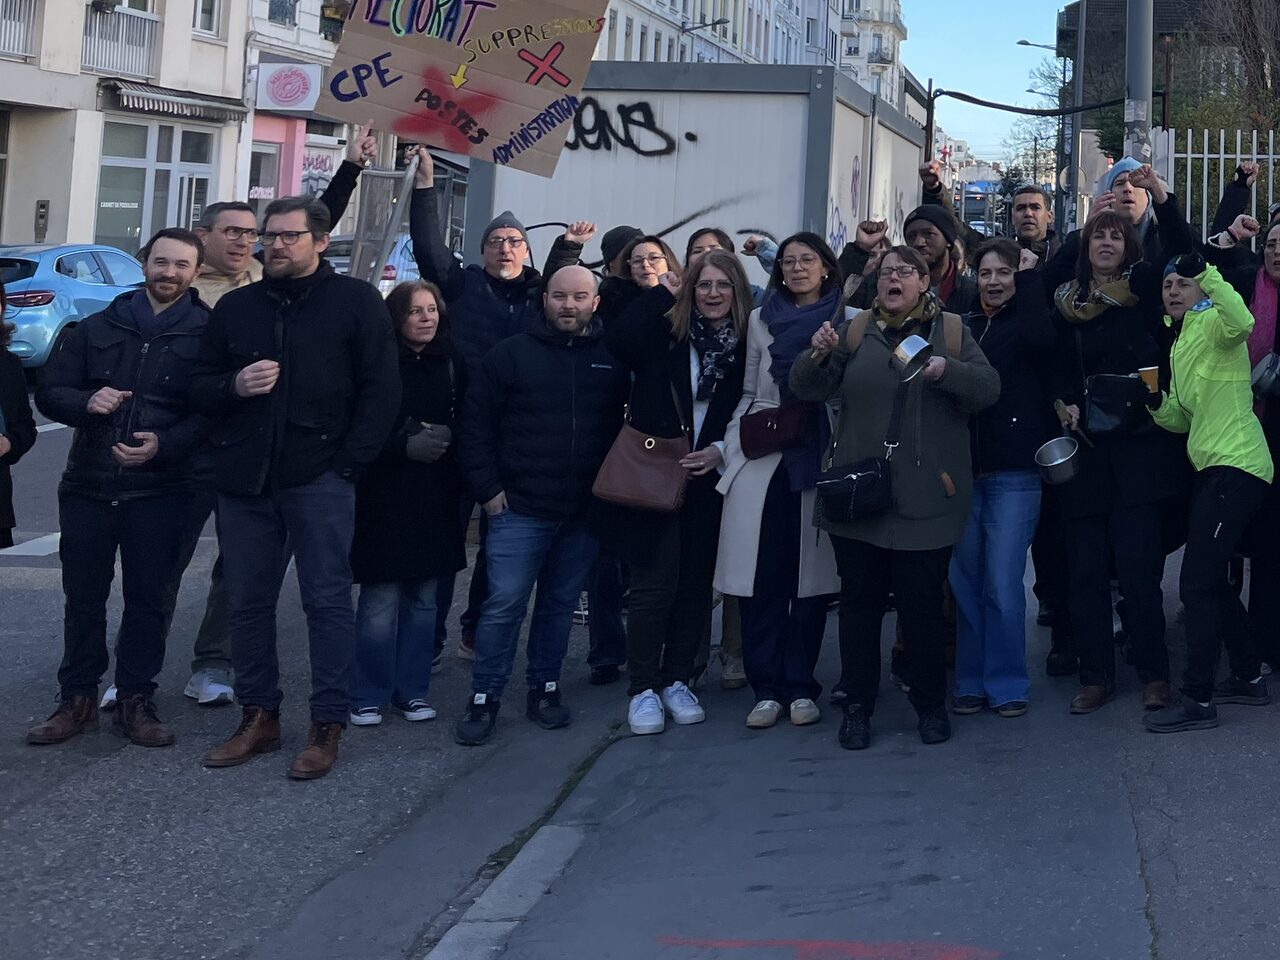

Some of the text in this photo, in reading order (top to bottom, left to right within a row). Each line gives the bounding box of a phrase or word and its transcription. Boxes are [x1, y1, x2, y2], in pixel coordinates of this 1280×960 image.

[329, 52, 403, 102] CPE
[414, 88, 489, 145] POSTES
[491, 94, 580, 164] ADMINISTRATION
